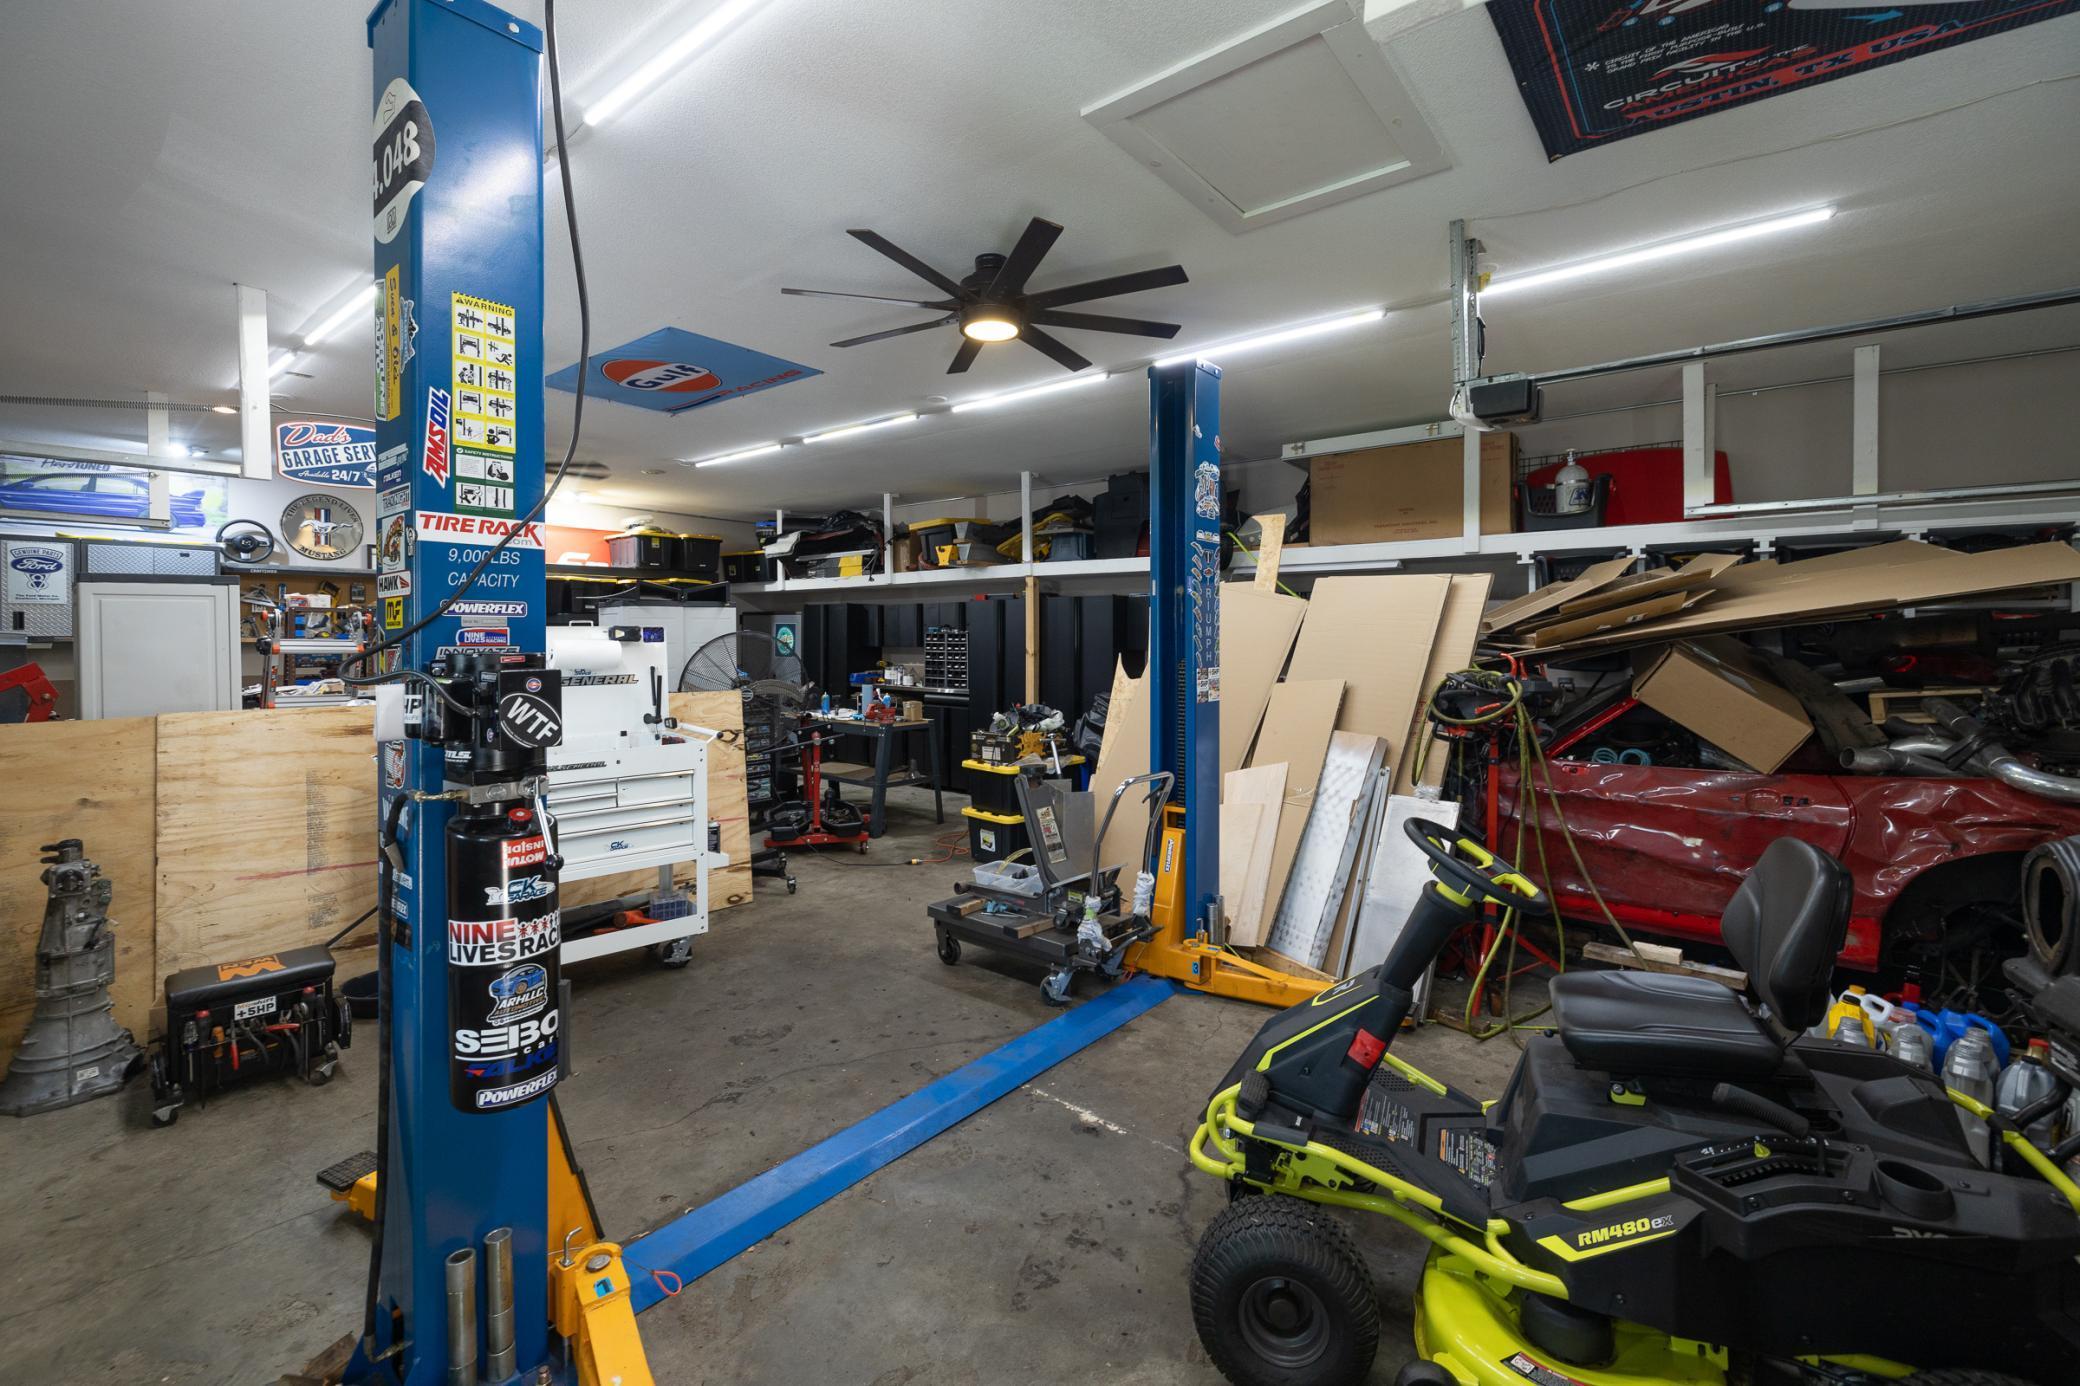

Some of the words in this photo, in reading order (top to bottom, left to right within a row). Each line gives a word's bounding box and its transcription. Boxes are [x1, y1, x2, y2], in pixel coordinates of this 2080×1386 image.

[1793, 50, 1856, 75] TX
[1869, 19, 1965, 54] USA
[1603, 61, 1745, 110] CIRCUIT
[464, 298, 513, 317] WARNING
[626, 364, 703, 390] Gulf
[284, 423, 351, 446] Dad's
[424, 391, 450, 482] AMSOIL
[282, 447, 341, 468] GARAGE
[332, 469, 360, 482] 24/7
[301, 495, 338, 506] LEGEND
[419, 513, 476, 534] TIRE
[299, 544, 347, 559] MUSTANG
[16, 558, 58, 571] Ford
[379, 575, 399, 593] HAWK
[560, 674, 639, 687] GENERAL
[507, 696, 559, 741] WTF
[508, 874, 542, 895] CK
[449, 920, 516, 945] NINE
[450, 941, 517, 963] LIVES
[236, 1002, 275, 1018] +5HP
[479, 1069, 558, 1106] POWERFLEX
